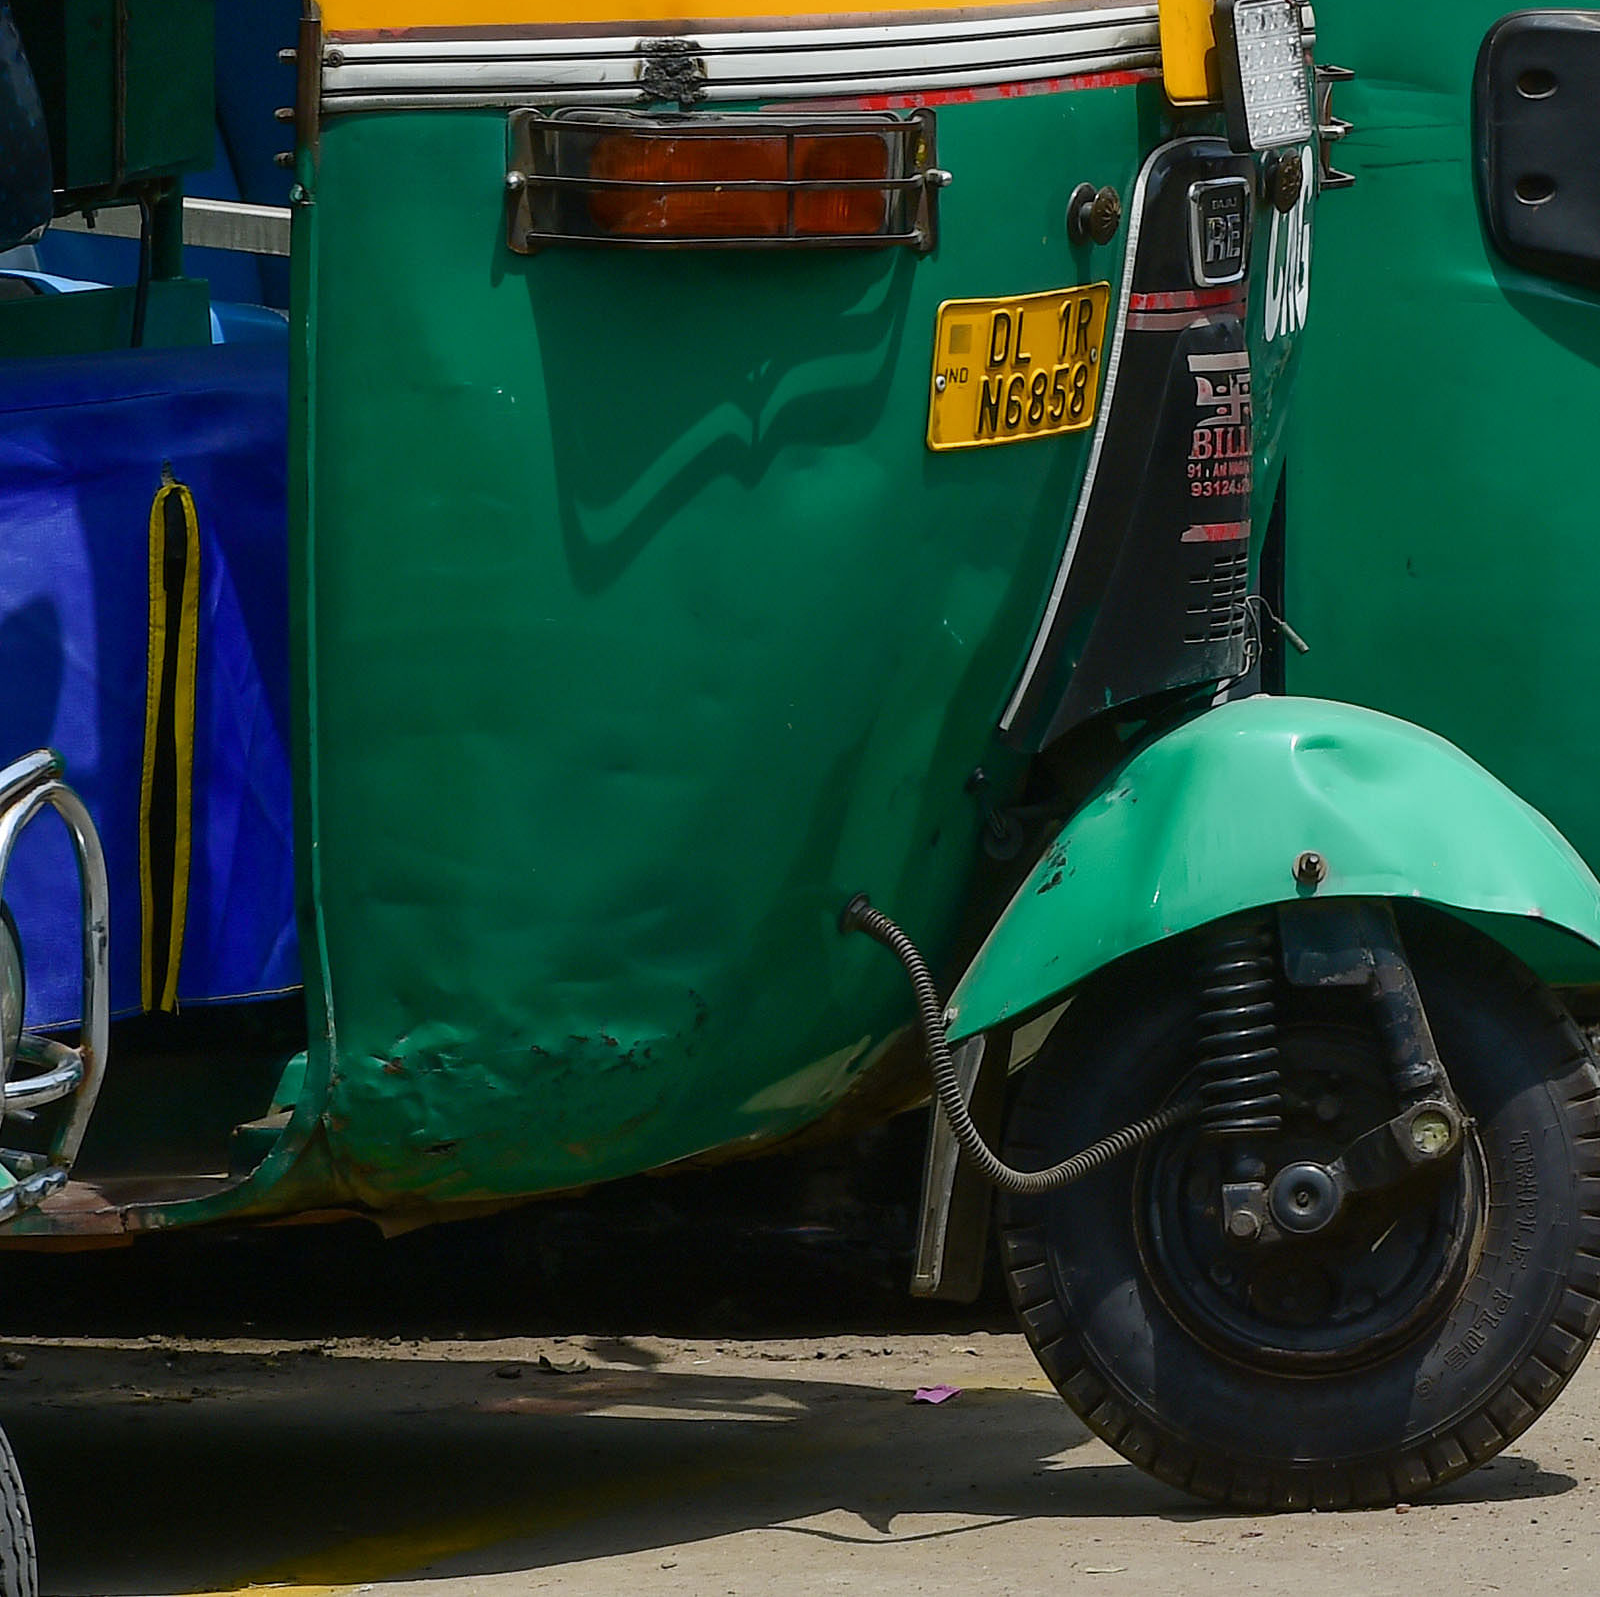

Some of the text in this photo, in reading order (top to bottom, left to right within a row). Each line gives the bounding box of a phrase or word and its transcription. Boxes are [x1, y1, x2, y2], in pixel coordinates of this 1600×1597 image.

[1205, 212, 1241, 263] RE
[986, 297, 1094, 370] DL 1R
[945, 367, 969, 385] IND
[974, 360, 1088, 438] N6858
